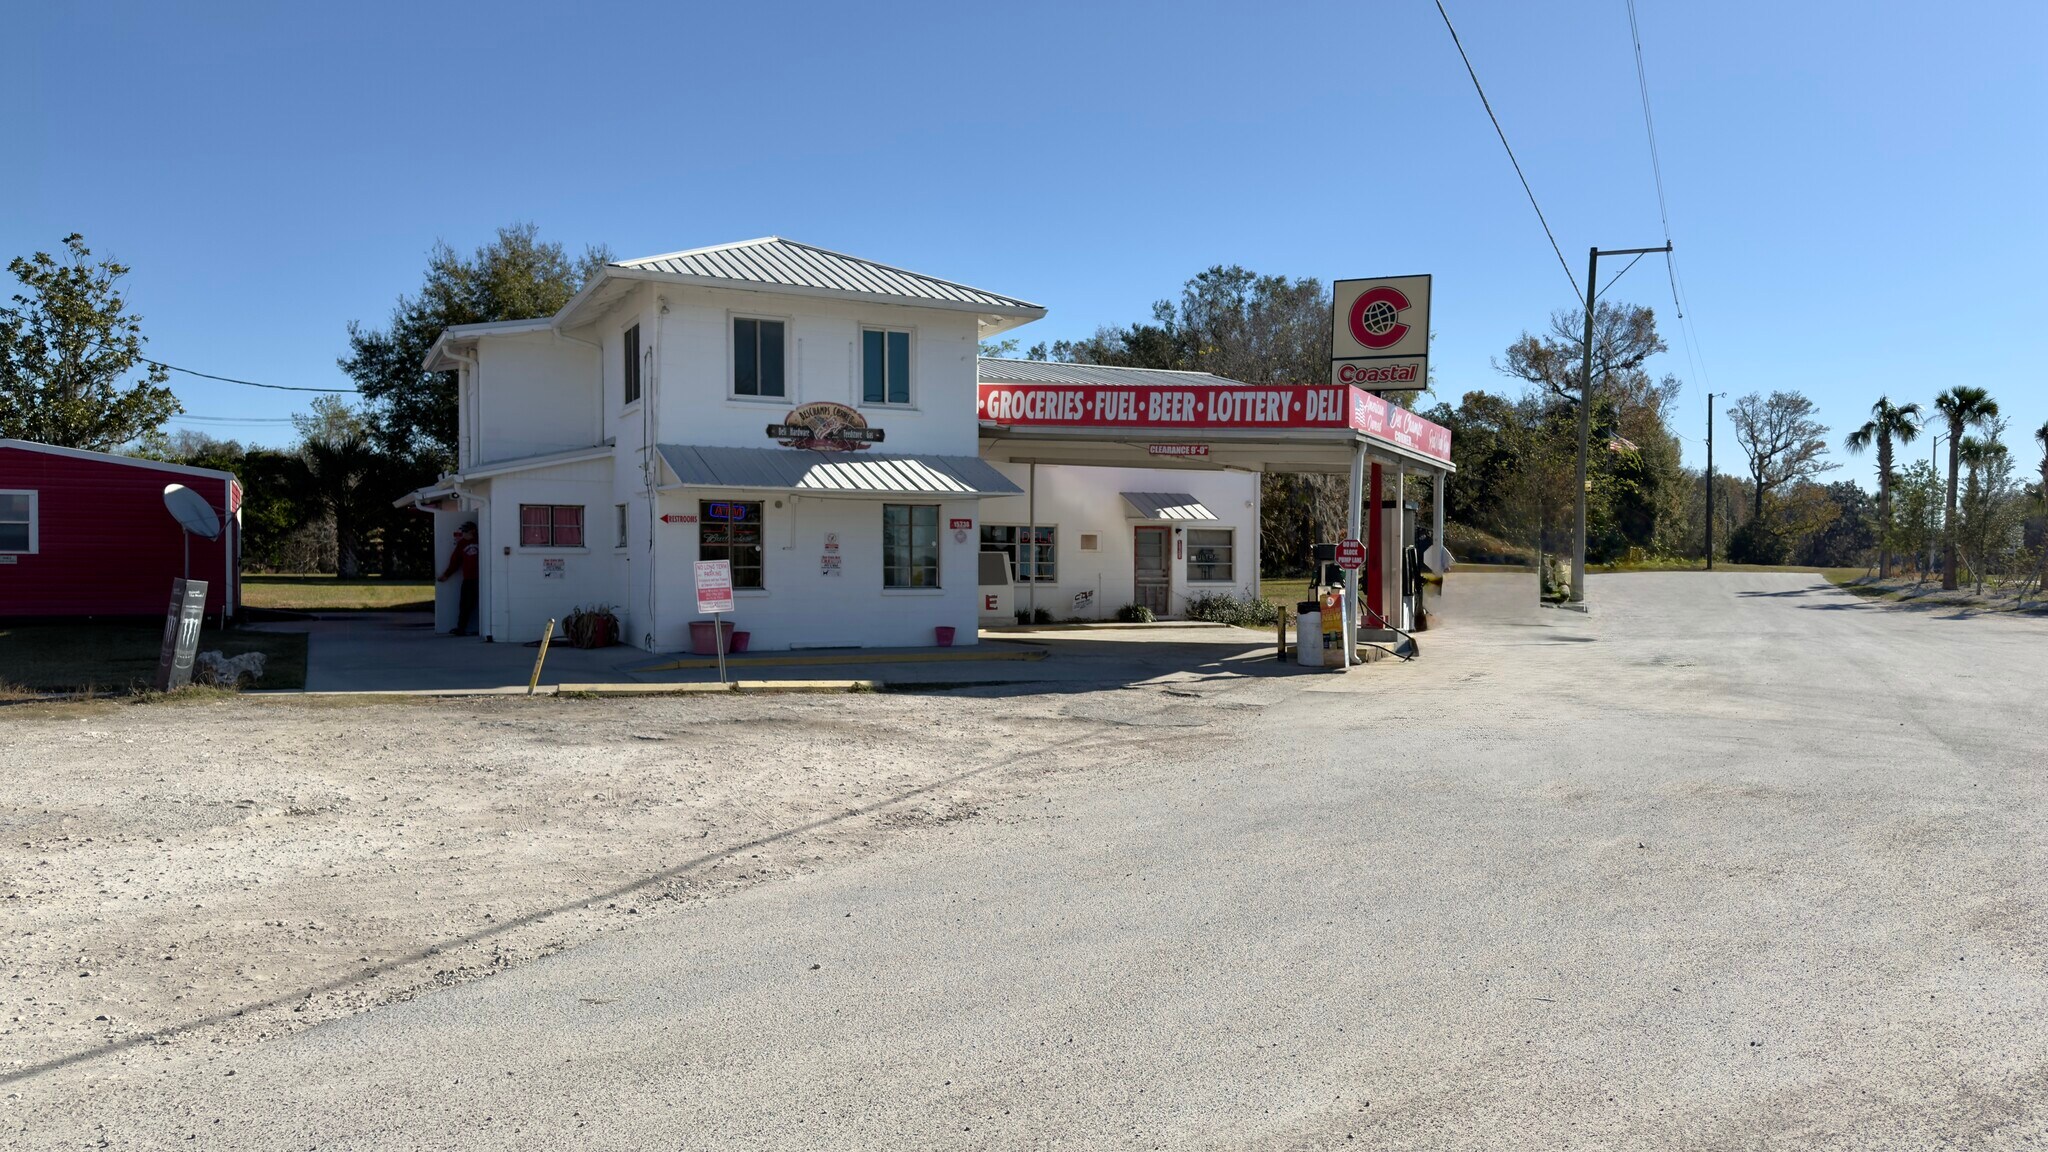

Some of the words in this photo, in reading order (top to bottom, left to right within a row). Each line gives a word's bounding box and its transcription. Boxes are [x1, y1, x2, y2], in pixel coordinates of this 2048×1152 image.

[1337, 364, 1418, 384] Coastal
[799, 406, 830, 420] DESCHAMPS
[987, 390, 1084, 420] GROCERIES
[1094, 391, 1138, 421] FUEL
[1148, 391, 1196, 421] BEER
[1207, 391, 1294, 422] LOTTERY
[1305, 389, 1344, 421] DELI
[1363, 396, 1385, 417] American
[1367, 415, 1383, 432] Owned
[1403, 413, 1424, 442] Champs
[790, 427, 810, 437] Hardware
[866, 431, 874, 439] Gas
[1150, 445, 1189, 454] CLEARANCE
[715, 506, 742, 516] ATM
[668, 515, 698, 523] RESTROOMS
